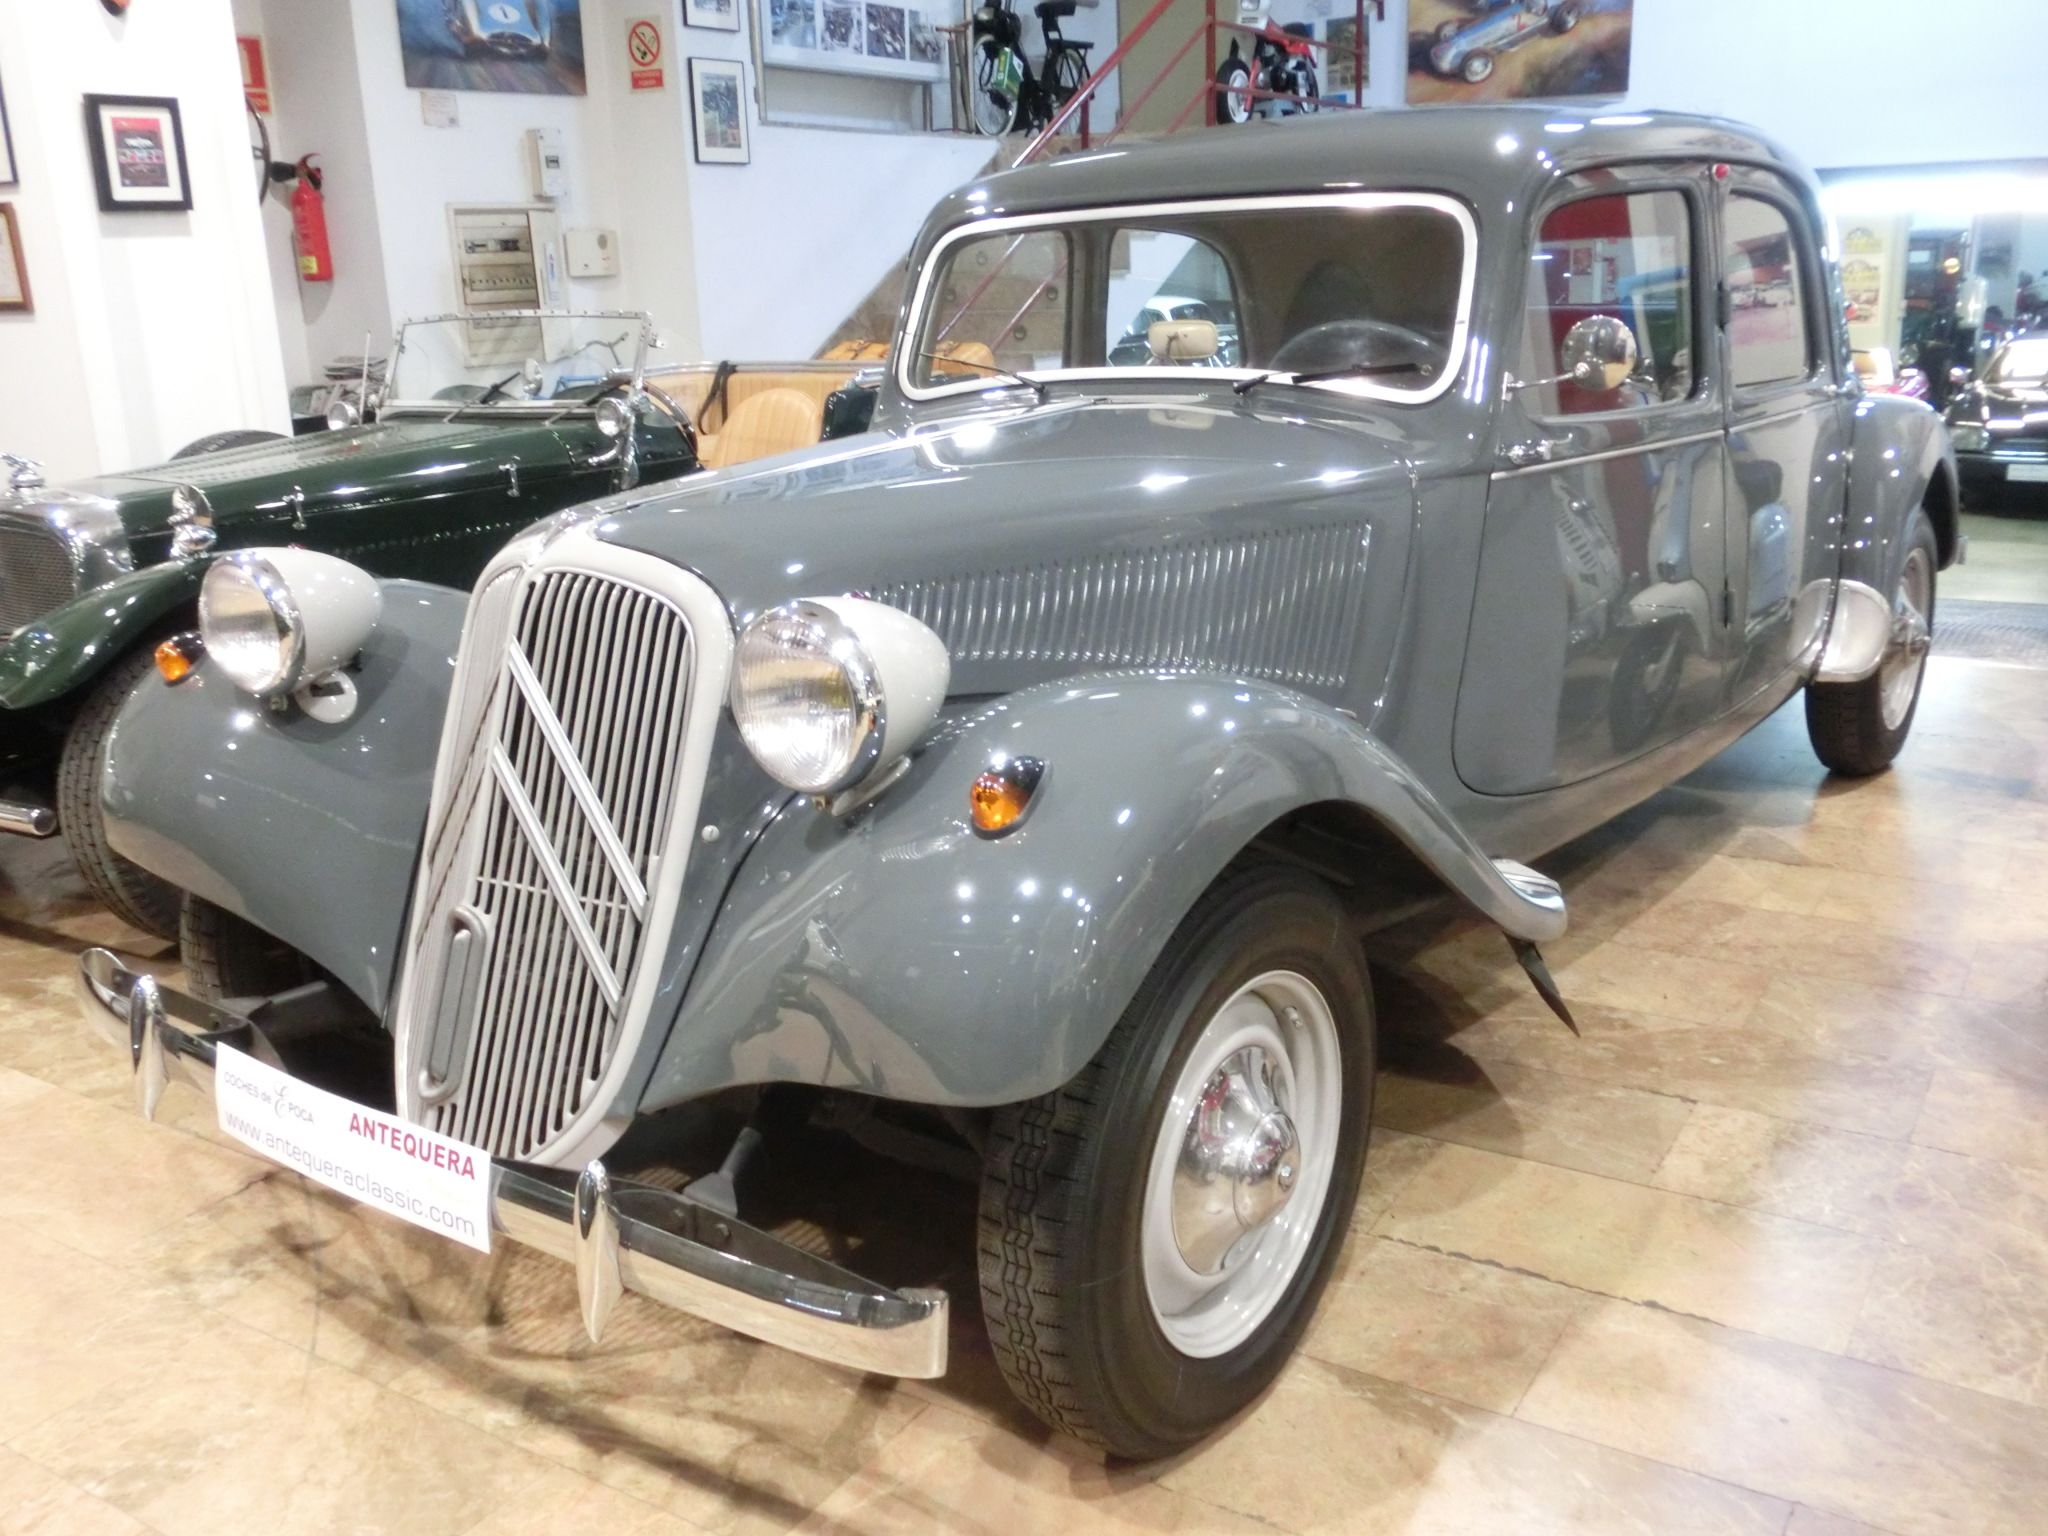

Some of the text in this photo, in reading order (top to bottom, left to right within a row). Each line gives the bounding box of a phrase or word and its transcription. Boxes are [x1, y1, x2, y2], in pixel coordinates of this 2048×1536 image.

[224, 1071, 260, 1098] COCHES
[225, 1111, 476, 1238] www.antequeraclassic.com
[349, 1112, 476, 1181] ANTEQUERA
